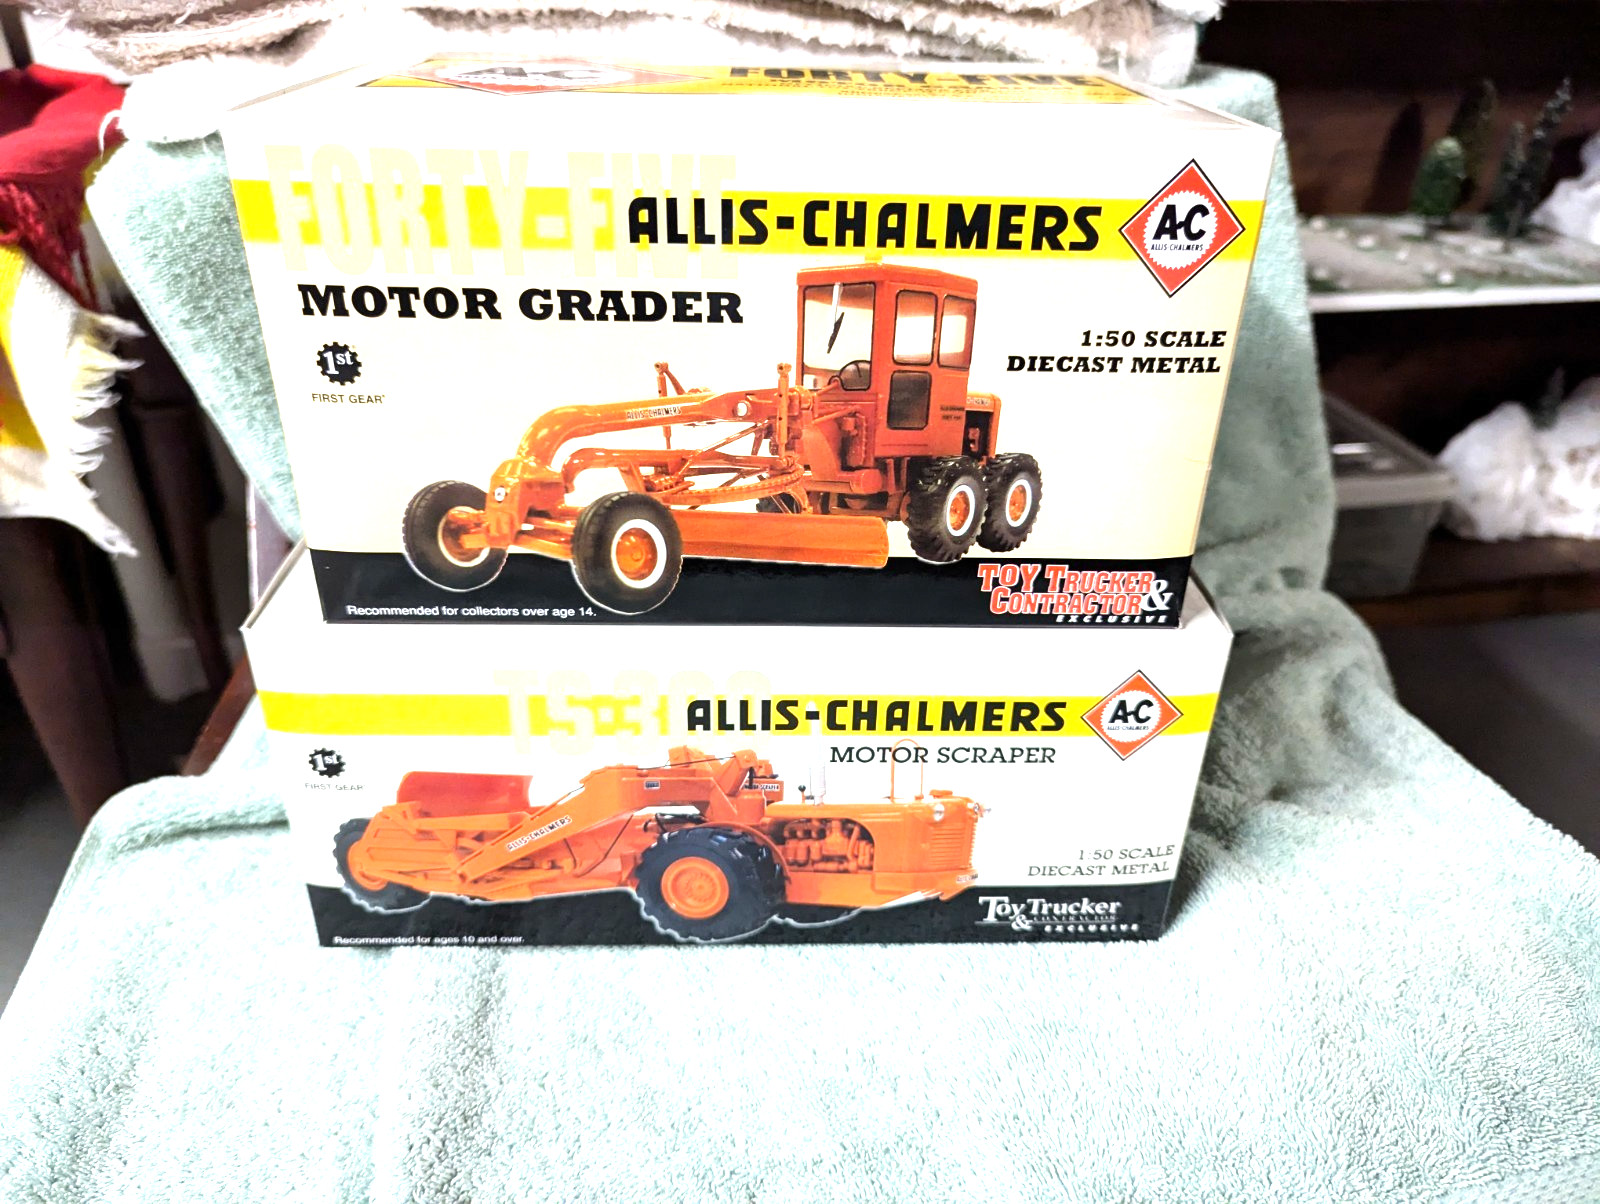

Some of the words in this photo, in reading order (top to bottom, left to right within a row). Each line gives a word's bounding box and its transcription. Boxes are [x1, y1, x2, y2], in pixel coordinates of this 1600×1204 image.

[730, 67, 1106, 87] FORTY-FIVE
[264, 144, 738, 279] FORTY-FIVE
[629, 197, 1102, 252] ALLIS-CHALMERS
[1152, 204, 1210, 241] A-C
[297, 284, 502, 320] MOTOR
[519, 288, 744, 323] GRADER
[1081, 331, 1136, 347] 1:50
[1145, 331, 1227, 348] SCALE
[323, 350, 354, 375] 1st
[1007, 355, 1121, 373] DIECAST
[1130, 356, 1221, 374] METAL
[312, 393, 344, 403] FIRST
[977, 563, 1041, 592] TOY
[1045, 564, 1155, 594] TRUCKER
[1140, 579, 1174, 611] &
[990, 586, 1143, 615] CONTRACTOR
[347, 605, 439, 616] Recommended
[442, 605, 459, 616] for
[461, 605, 519, 617] collectors
[522, 608, 549, 617] over
[552, 608, 575, 619] age
[579, 607, 598, 617] 14.
[1056, 614, 1168, 623] EXCLUSIVE
[687, 700, 1067, 733] ALLIS-CHALMERS
[1108, 699, 1154, 723] A-C
[830, 747, 929, 763] MOTOR
[937, 747, 1057, 764] SCRAPER
[304, 782, 331, 790] FIRST
[1079, 849, 1113, 861] 1:50
[1119, 844, 1175, 860] SCALE
[1028, 865, 1106, 877] DIECAST
[1111, 861, 1170, 875] METAL
[978, 896, 1026, 922] Toy
[1026, 897, 1122, 916] Trucker
[1011, 914, 1034, 931] &
[333, 936, 415, 944] Recommended
[417, 935, 431, 944] for
[434, 937, 460, 945] ages
[500, 936, 525, 944] over.
